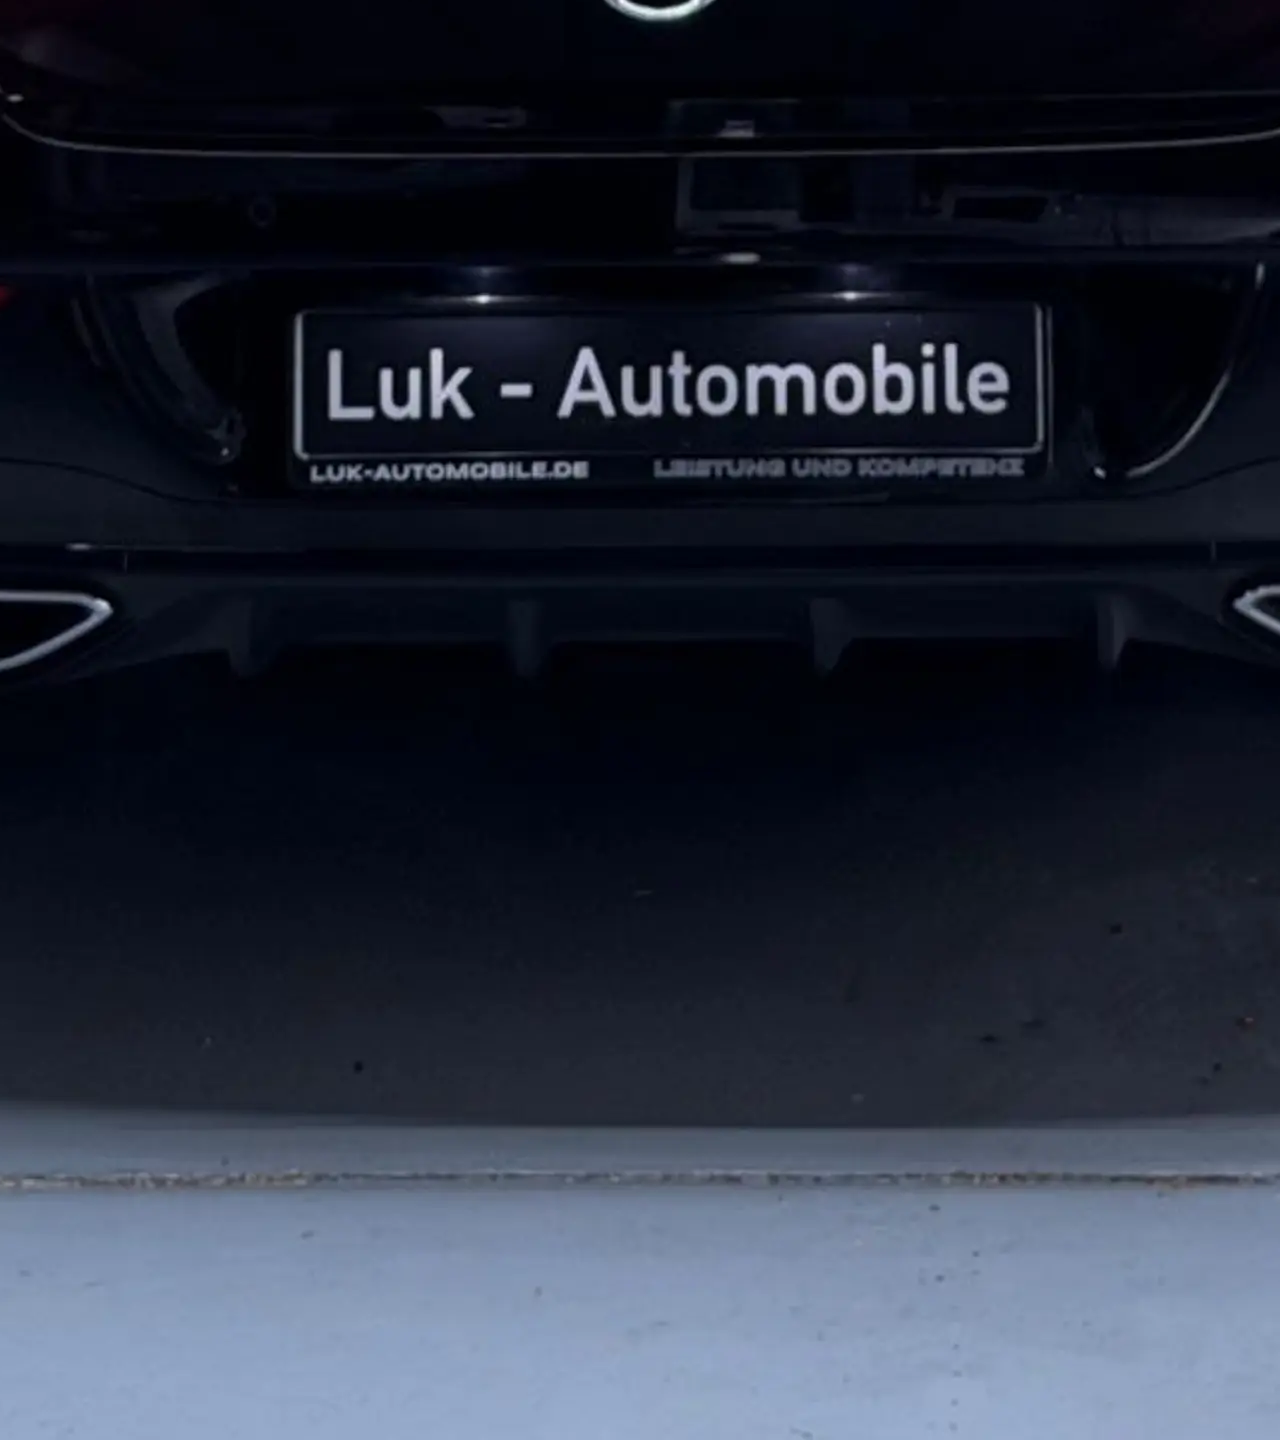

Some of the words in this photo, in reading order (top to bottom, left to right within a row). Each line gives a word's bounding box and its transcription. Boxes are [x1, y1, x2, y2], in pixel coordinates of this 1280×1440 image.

[328, 347, 475, 421] Luk
[556, 342, 1010, 419] Automobile
[309, 460, 590, 483] LUK-AUTOMOBILE.DE
[791, 458, 853, 478] UND
